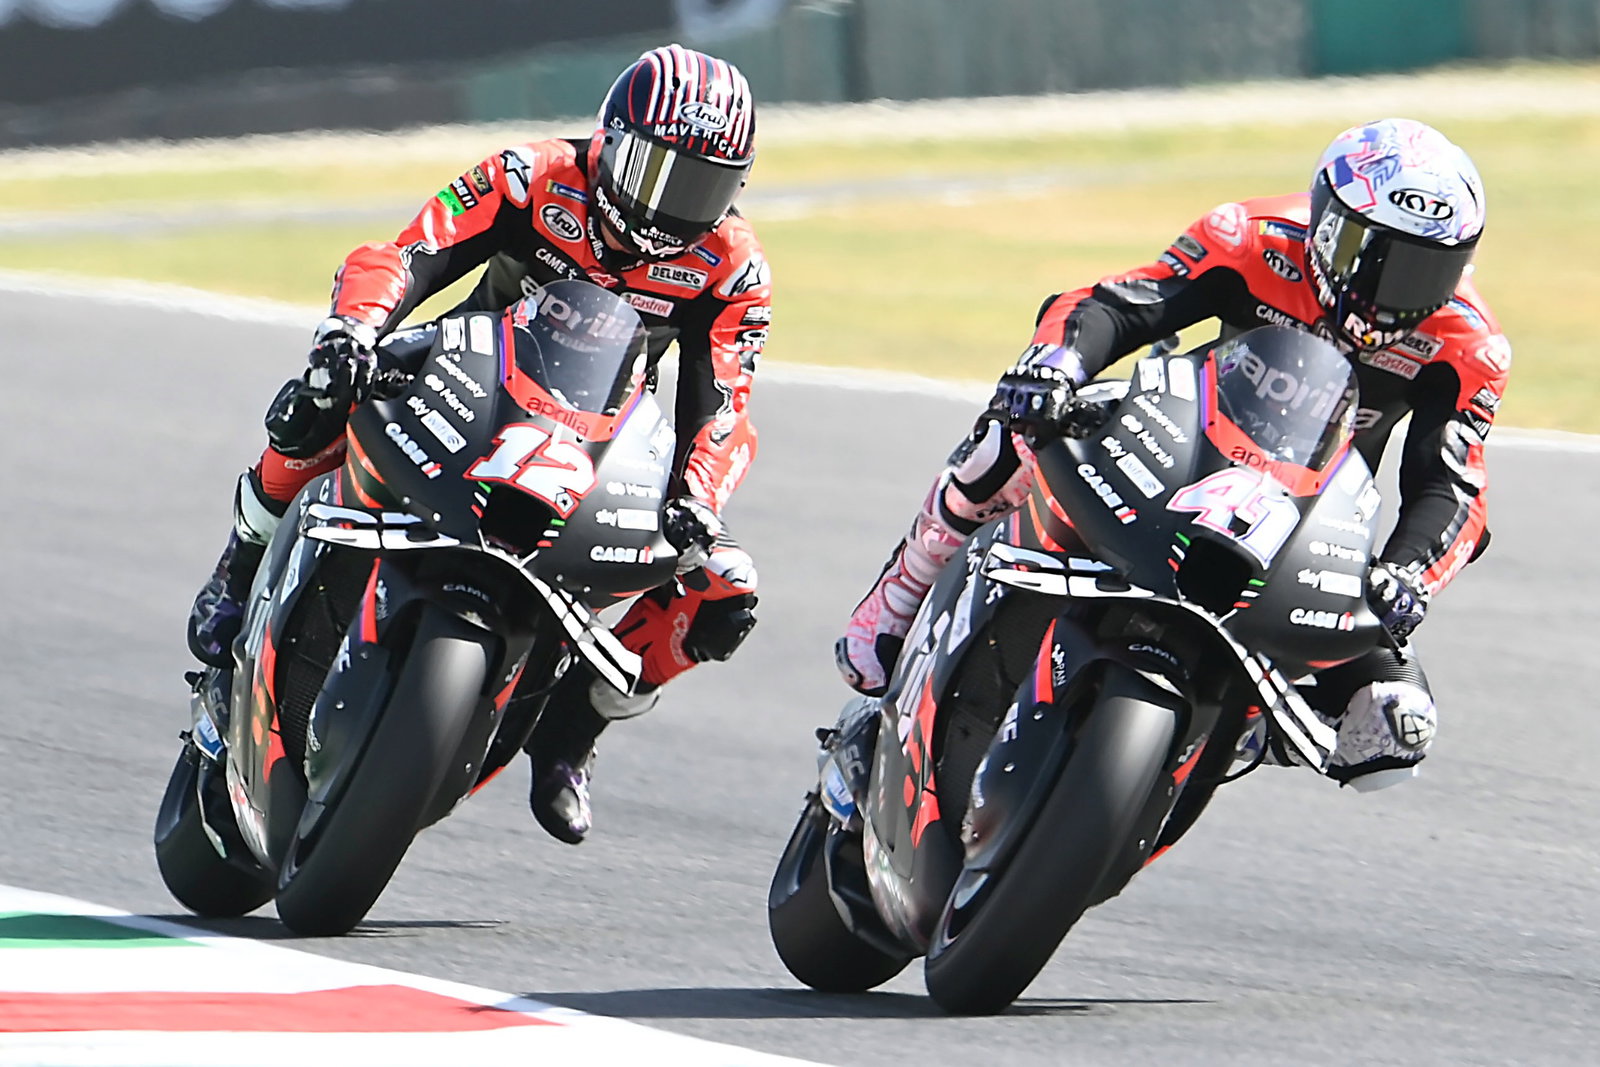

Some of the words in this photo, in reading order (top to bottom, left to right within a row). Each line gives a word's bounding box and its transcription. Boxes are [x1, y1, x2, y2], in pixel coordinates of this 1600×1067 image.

[693, 106, 722, 126] Arai
[654, 123, 737, 159] MAVERICK
[595, 185, 627, 234] aprilia
[1390, 190, 1448, 216] KYT
[544, 209, 578, 235] Arai
[535, 248, 567, 276] CAME
[1265, 250, 1299, 280] KYT
[631, 296, 670, 314] Castrol
[1255, 304, 1294, 328] CAME
[1373, 353, 1417, 376] Castrol
[1241, 351, 1383, 430] aprilia
[406, 396, 430, 416] sky
[440, 386, 475, 423] Marsh
[526, 396, 589, 436] aprilia
[385, 422, 429, 465] CASE
[1101, 436, 1127, 458] sky
[462, 422, 599, 520] 12
[1231, 445, 1297, 489] aprilia
[1077, 463, 1124, 509] CASE
[595, 508, 618, 527] sky
[590, 545, 637, 564] CASE
[441, 584, 491, 602] CAME
[1290, 607, 1339, 629] CASE
[1128, 643, 1179, 666] CAME
